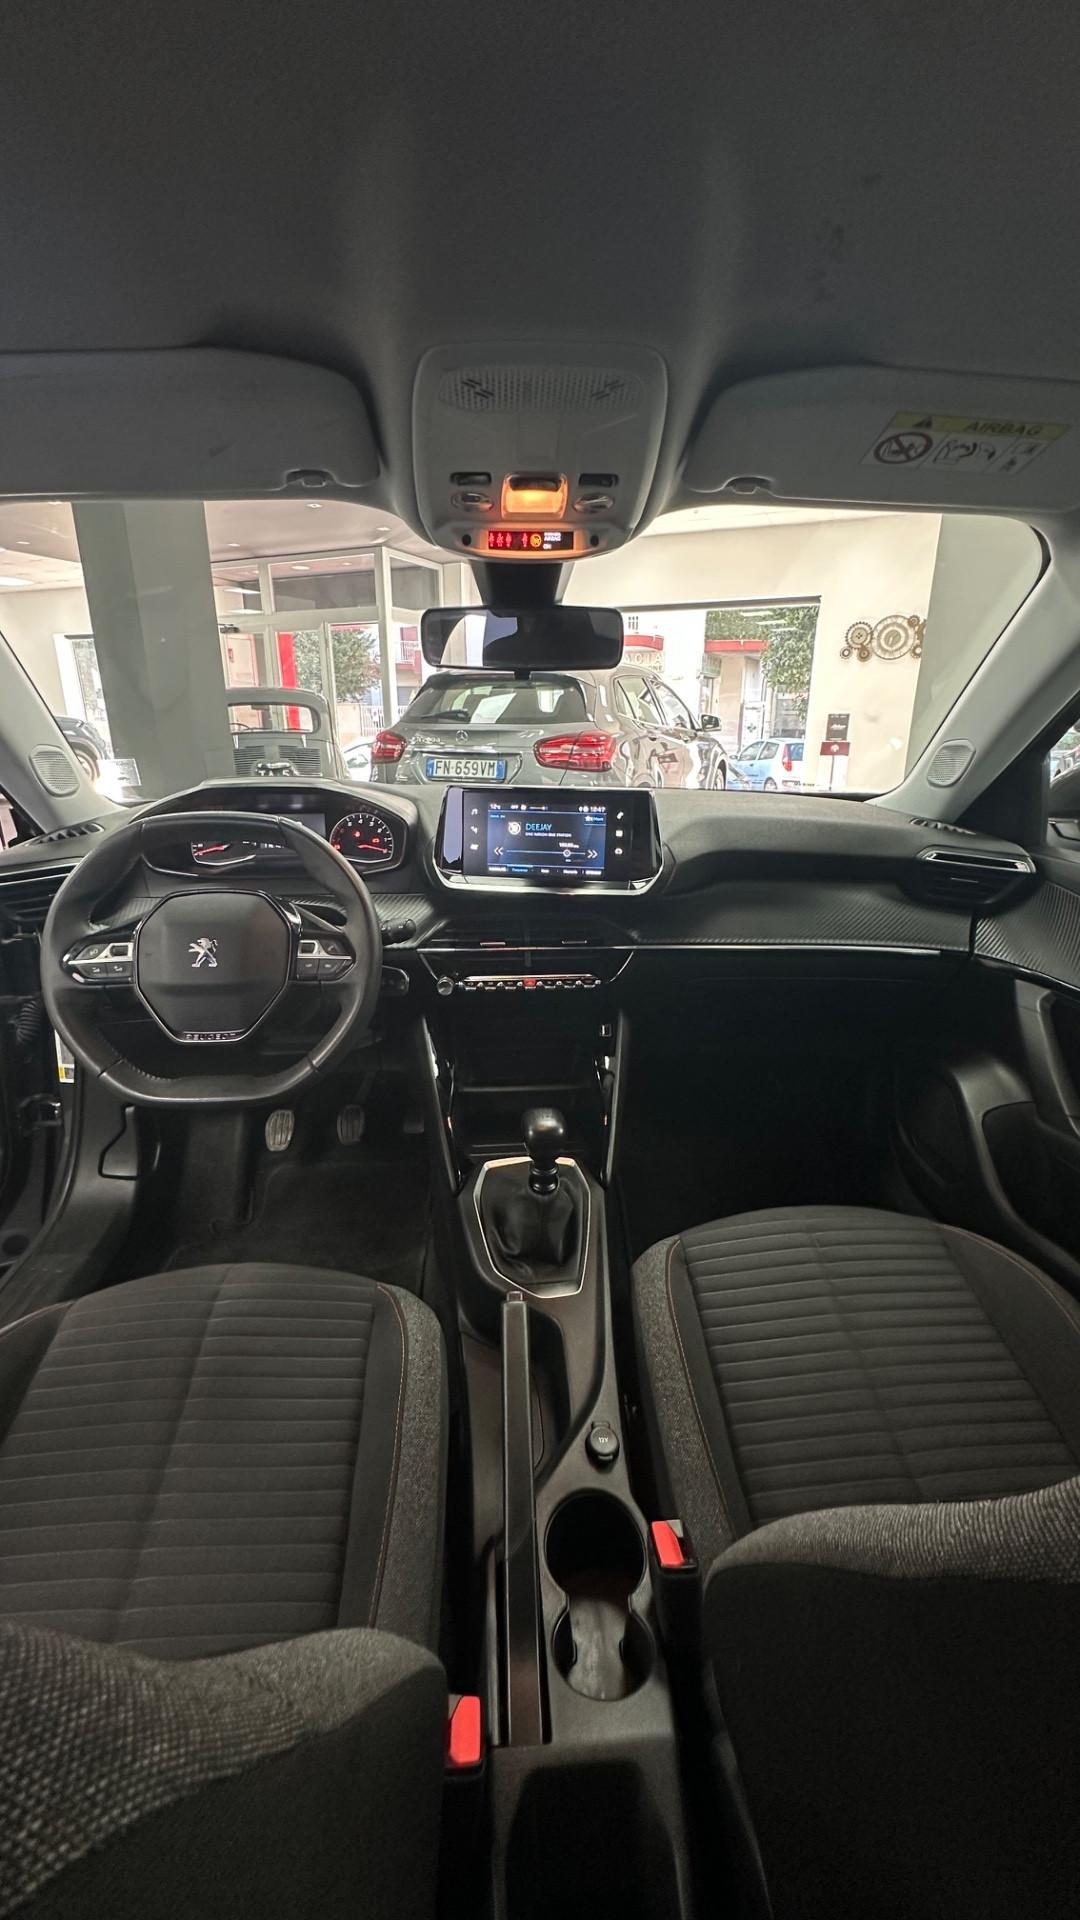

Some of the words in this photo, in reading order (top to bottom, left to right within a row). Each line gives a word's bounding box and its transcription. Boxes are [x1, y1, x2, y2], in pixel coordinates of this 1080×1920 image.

[963, 421, 1043, 436] AIRBAG
[435, 760, 451, 775] FN
[454, 761, 496, 777] 659VM
[525, 823, 553, 831] DEEJAY
